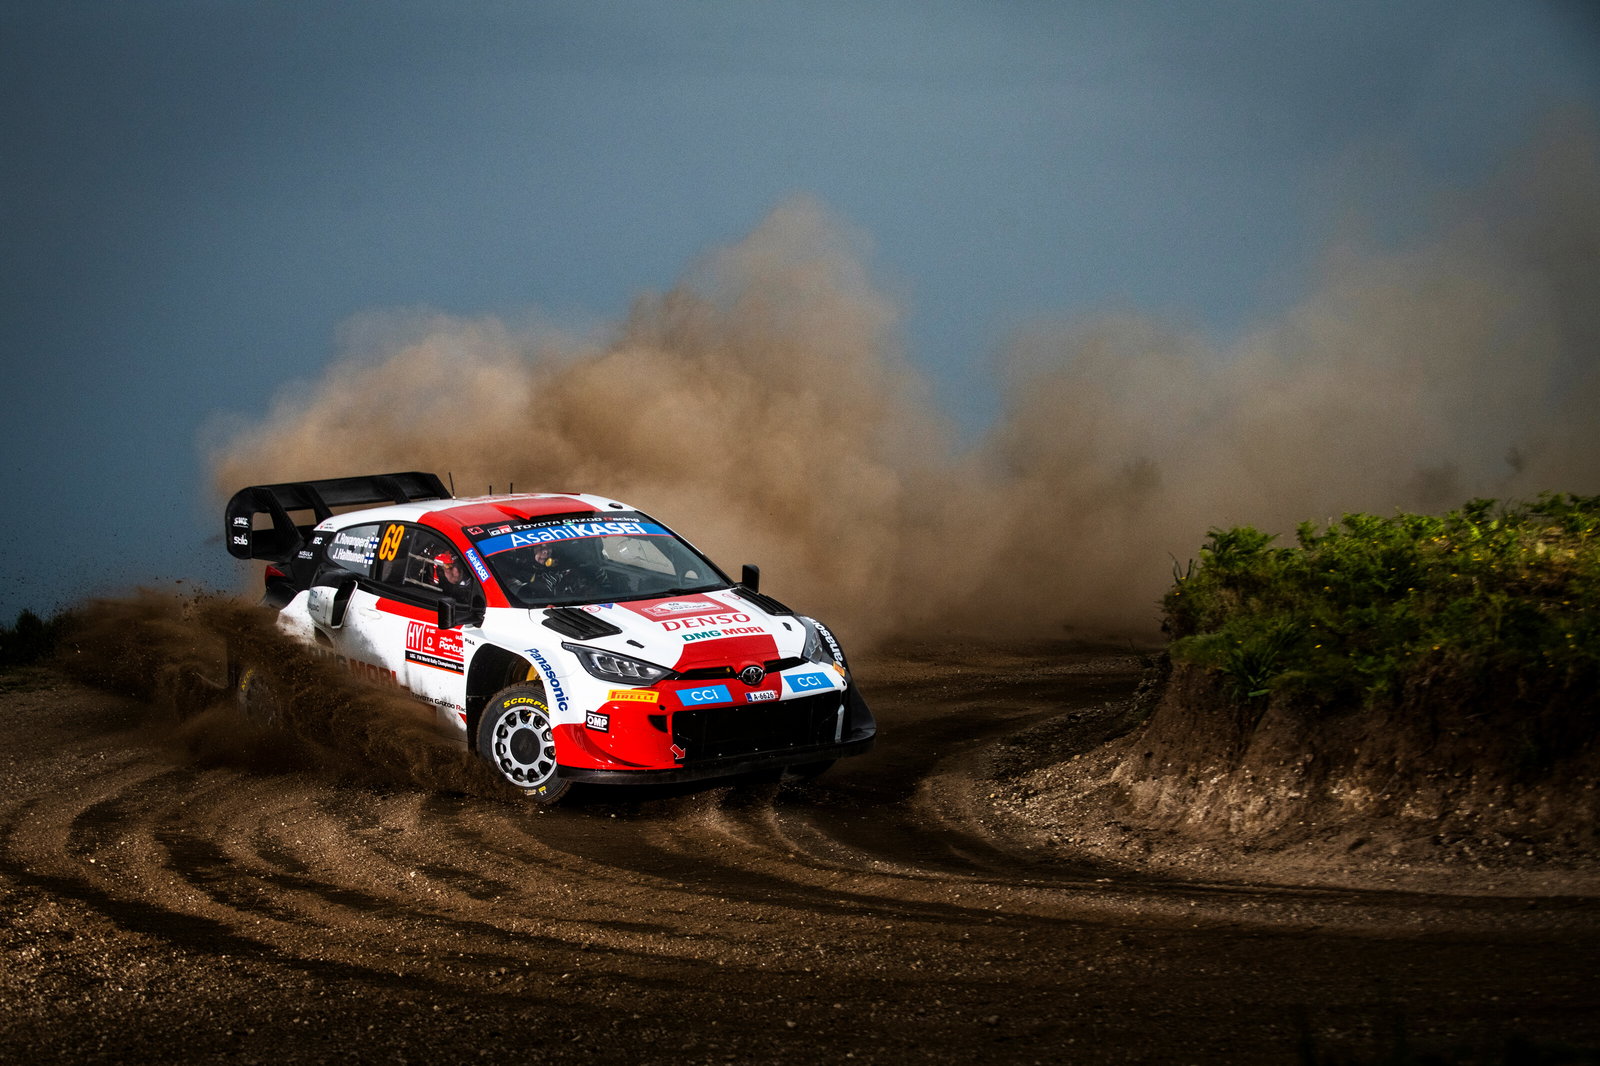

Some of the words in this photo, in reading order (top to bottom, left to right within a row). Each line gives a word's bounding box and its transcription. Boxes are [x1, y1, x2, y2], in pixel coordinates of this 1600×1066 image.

[513, 520, 560, 530] TOYOTA
[379, 523, 405, 561] 69
[511, 522, 647, 547] AsahiKASEI
[661, 613, 751, 631] DENSO
[682, 630, 721, 641] DMG
[723, 626, 765, 635] MORI
[524, 648, 569, 711] Panasonic
[411, 692, 434, 702] TOYOTA
[434, 699, 455, 709] GAZOO
[611, 691, 654, 701] PIRELLI
[587, 715, 608, 729] OMP
